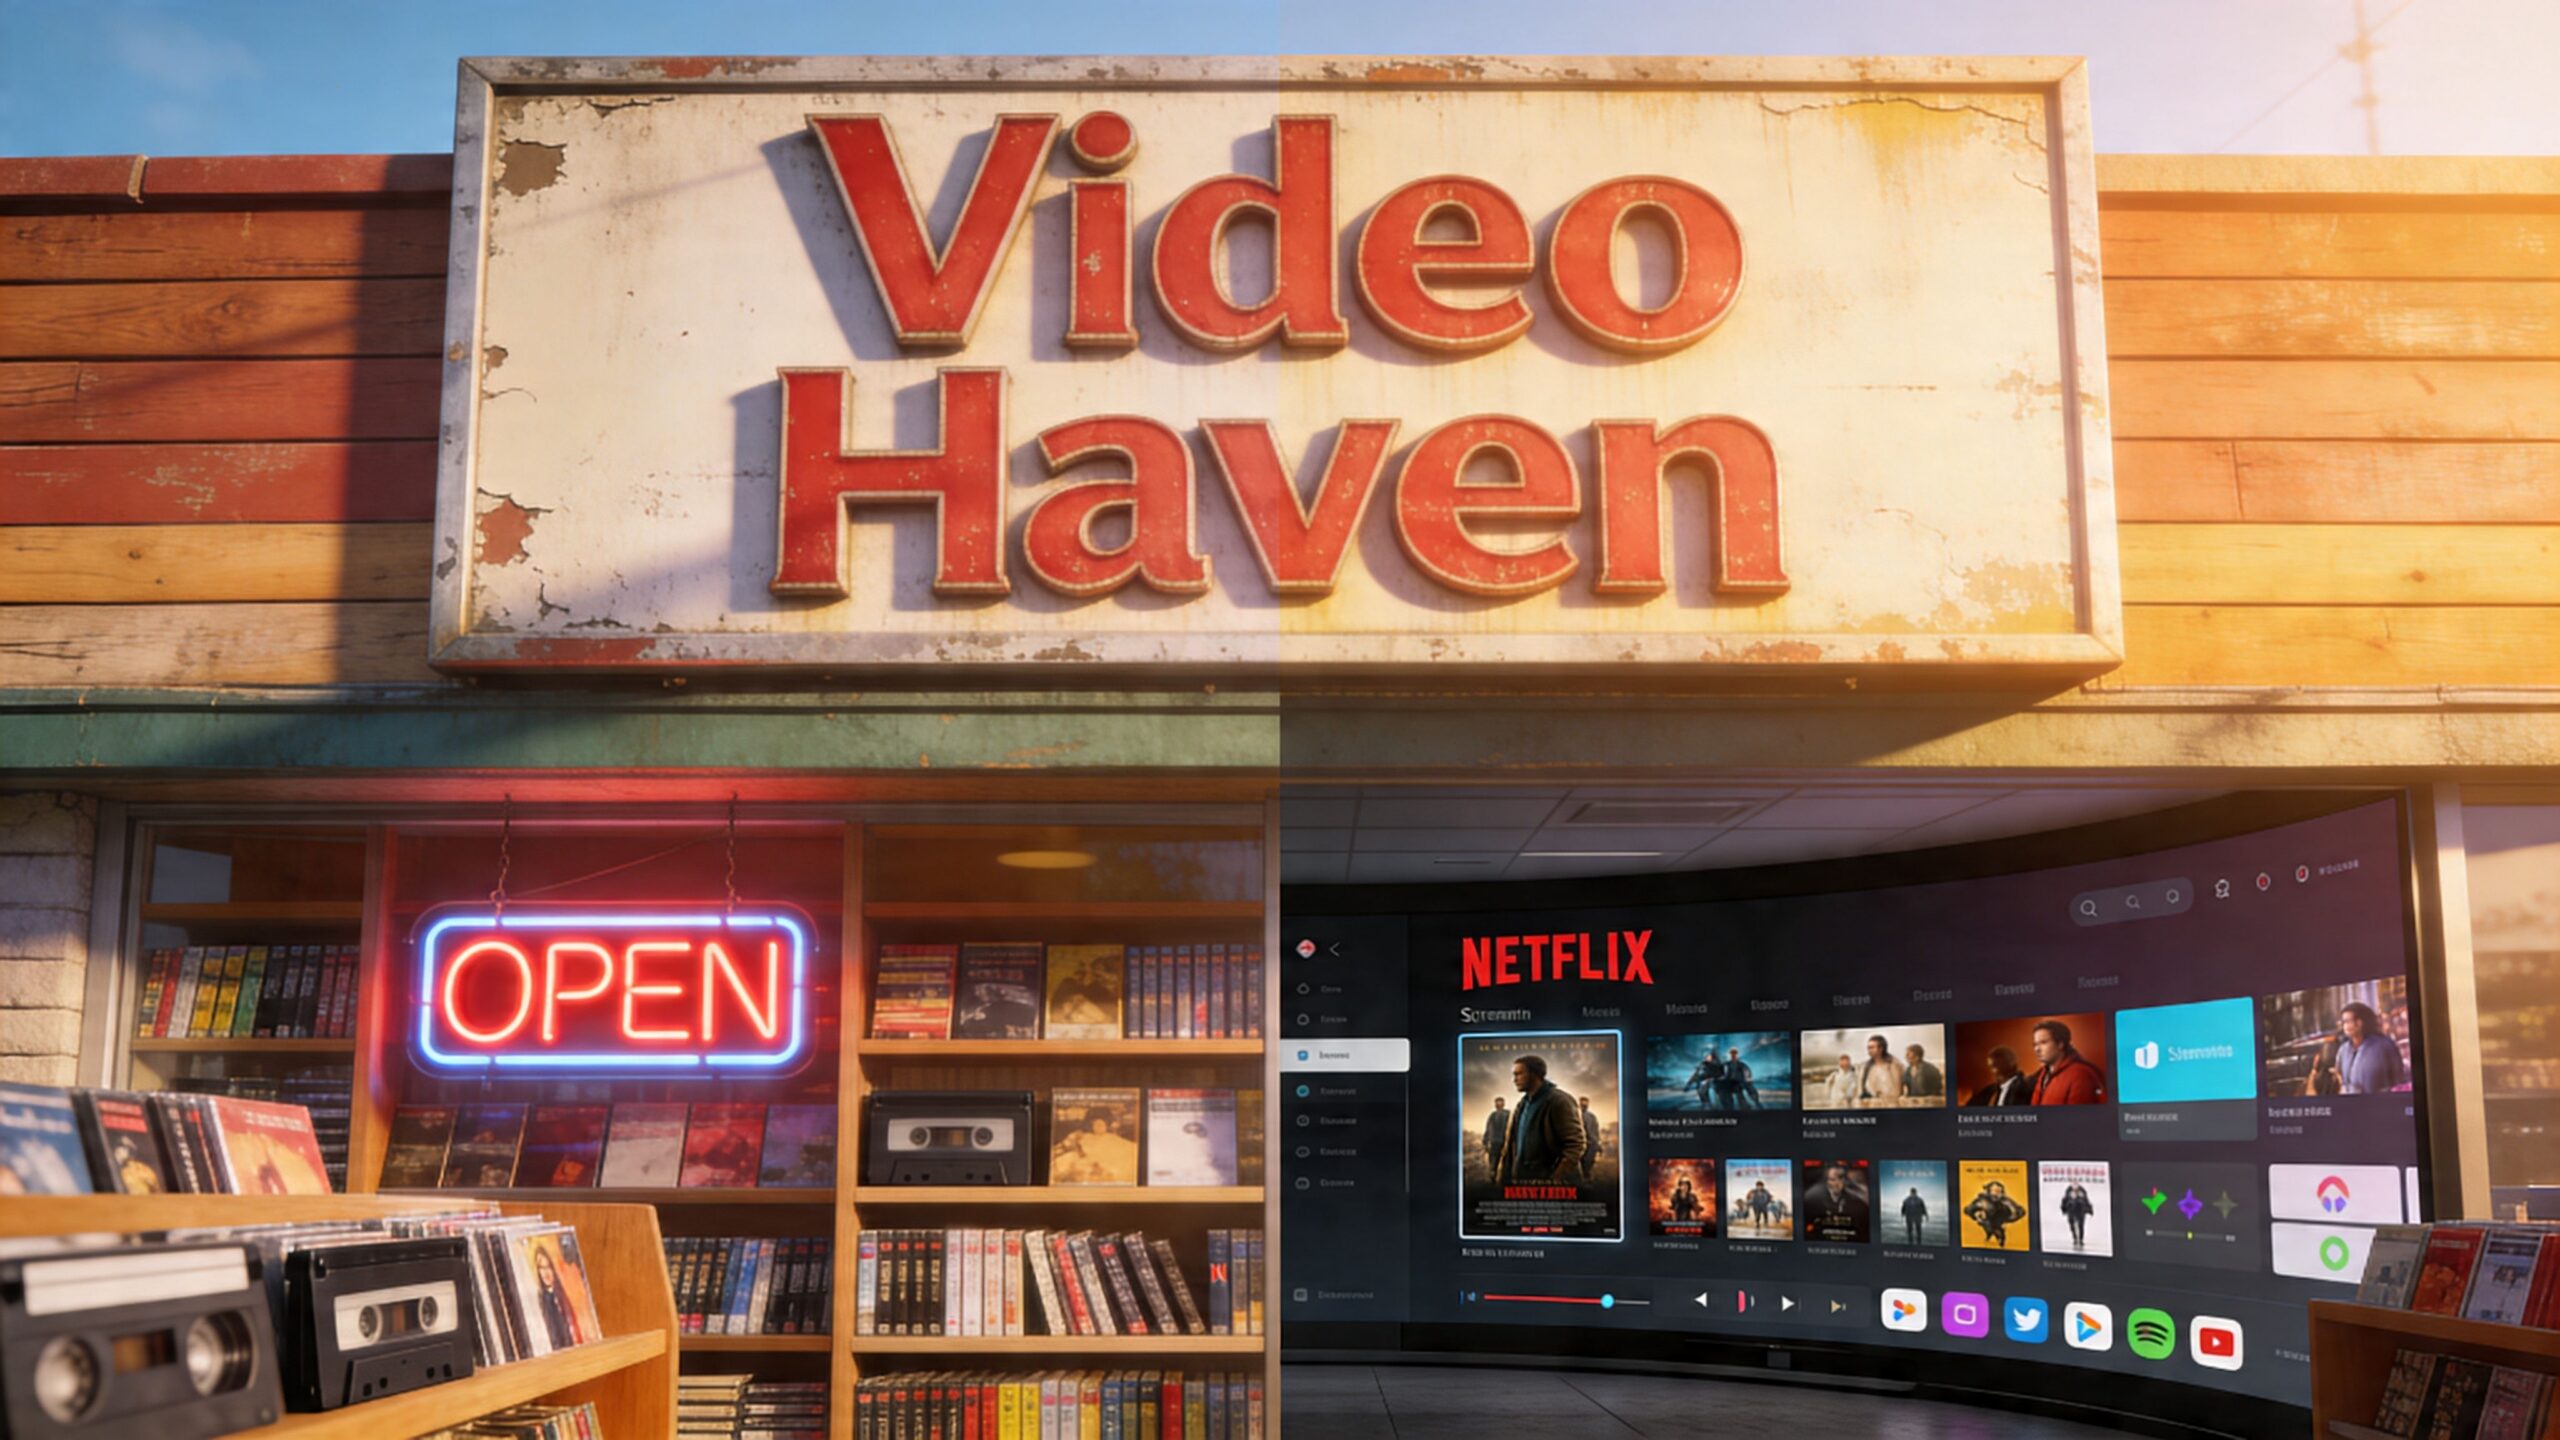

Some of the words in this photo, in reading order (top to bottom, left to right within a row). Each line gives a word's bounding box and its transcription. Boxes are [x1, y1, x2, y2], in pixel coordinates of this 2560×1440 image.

[804, 109, 1746, 355] Video
[770, 366, 1791, 598] Haven
[443, 940, 778, 1043] OPEN
[1462, 929, 1654, 991] NETFLIX
